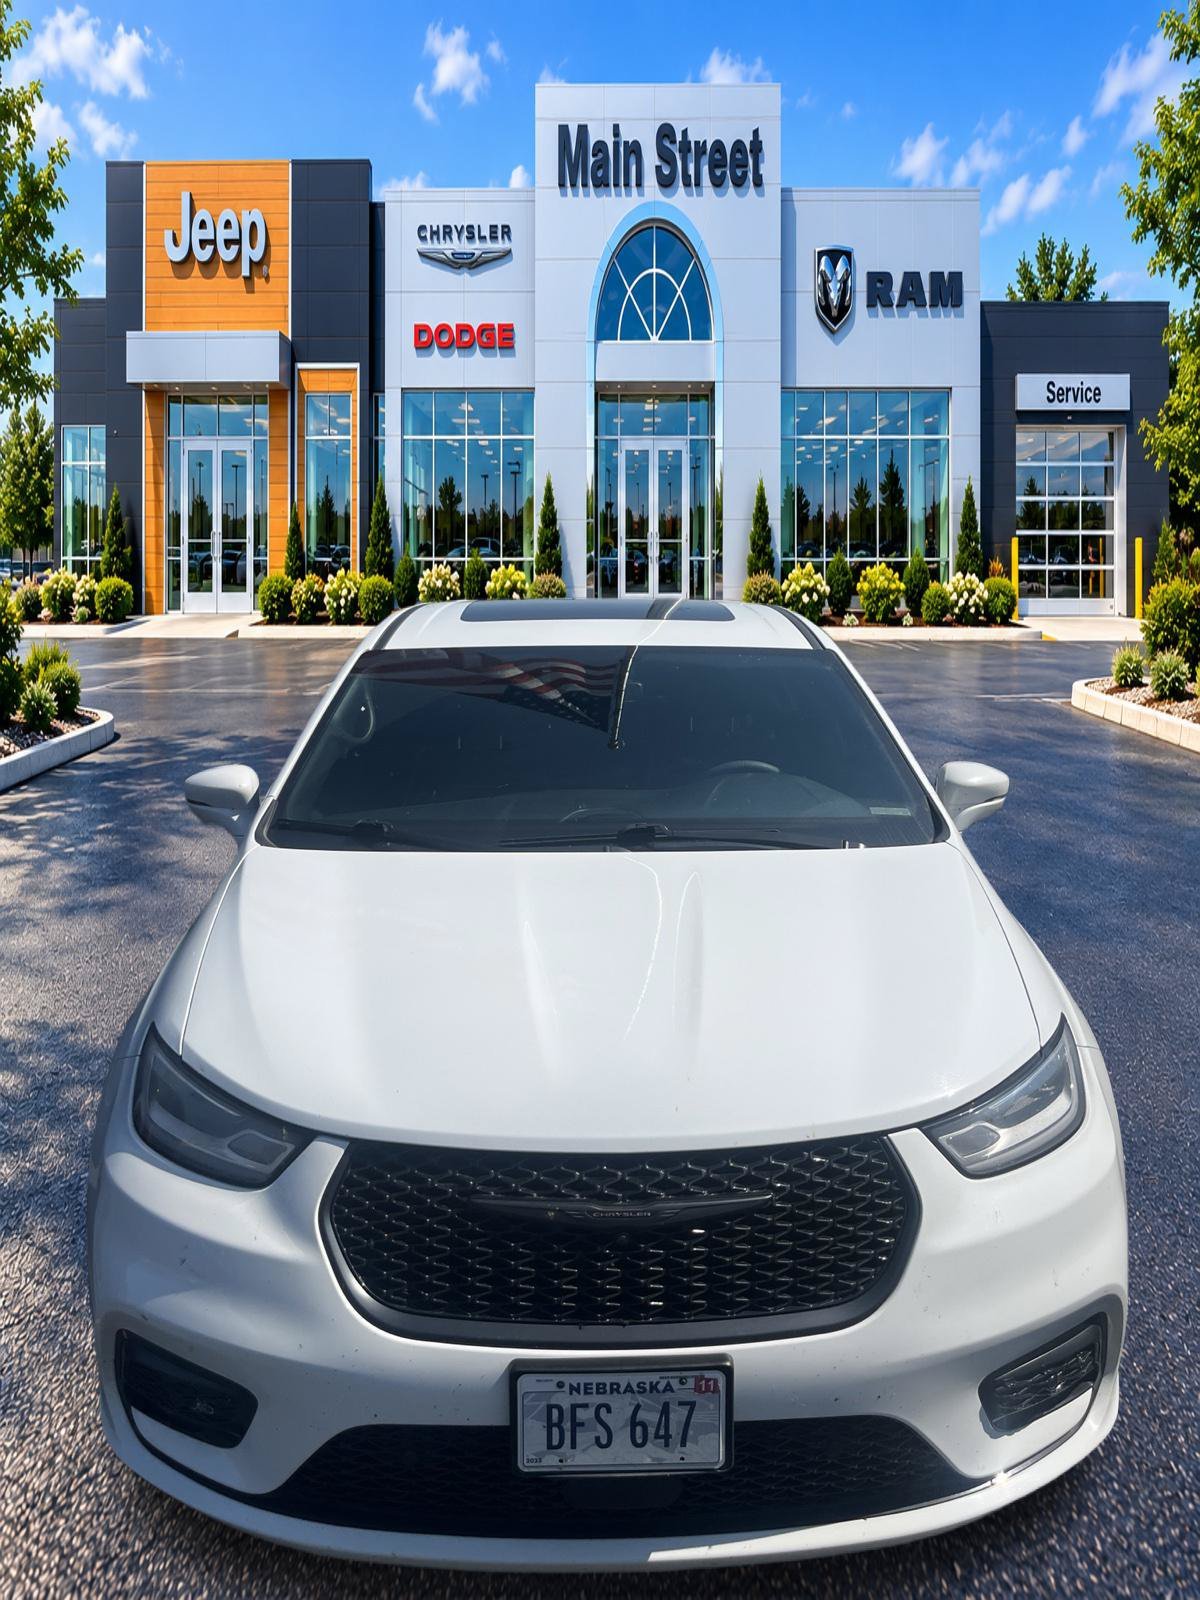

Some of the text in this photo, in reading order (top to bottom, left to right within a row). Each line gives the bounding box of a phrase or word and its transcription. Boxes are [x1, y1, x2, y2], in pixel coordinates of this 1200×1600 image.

[558, 122, 763, 188] Main Street
[164, 191, 266, 277] Jeep
[417, 224, 512, 242] CHRYSLER
[866, 271, 963, 308] RAM
[413, 323, 515, 349] DODGE
[1046, 381, 1102, 404] Service
[592, 1210, 652, 1218] CHRYSLER
[568, 1379, 675, 1396] NEBRASKA
[700, 1379, 715, 1392] 11
[546, 1400, 697, 1451] BFS 647
